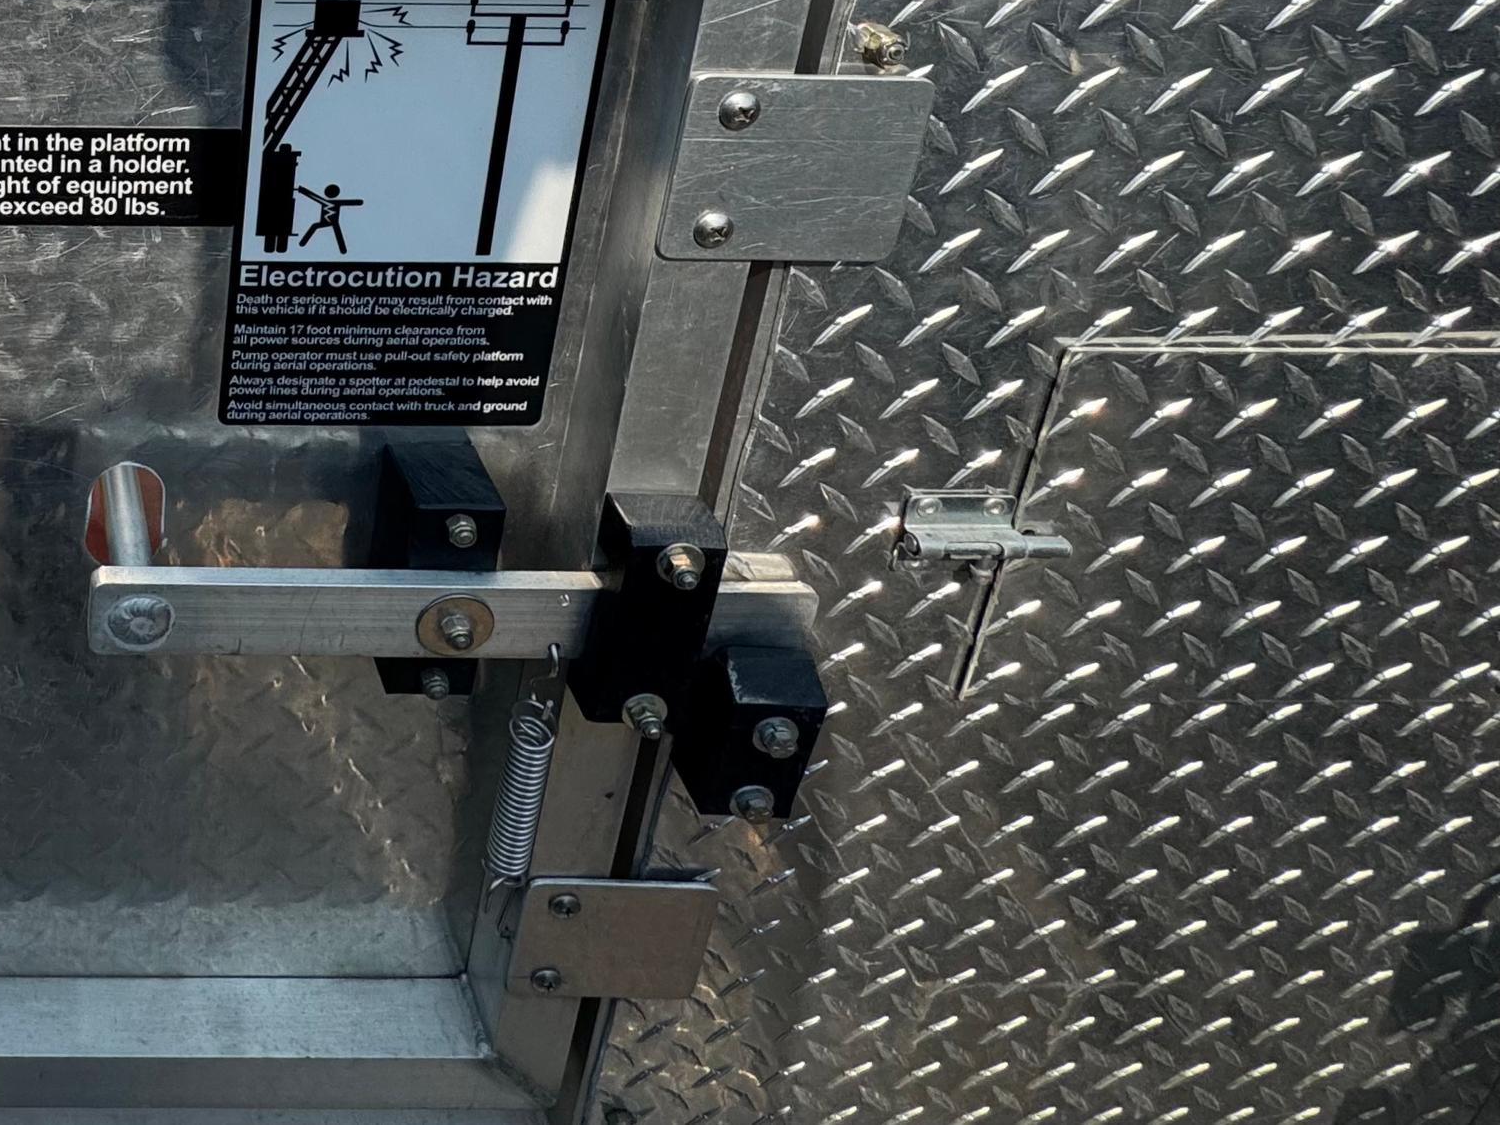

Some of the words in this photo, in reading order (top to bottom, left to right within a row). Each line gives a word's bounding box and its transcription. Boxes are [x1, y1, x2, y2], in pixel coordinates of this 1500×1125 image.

[18, 133, 39, 151] in
[46, 133, 83, 152] the
[91, 134, 190, 155] platform
[60, 155, 81, 172] in
[88, 160, 102, 173] a
[110, 155, 190, 173] holder.
[37, 177, 59, 194] of
[66, 177, 193, 199] equipment
[0, 198, 83, 215] exceed
[90, 199, 117, 215] 80
[125, 199, 166, 216] lbs.
[239, 265, 442, 288] Electrocution
[452, 266, 558, 288] Hazard
[237, 294, 273, 304] Death
[276, 296, 290, 304] or
[292, 295, 337, 304] serious
[341, 295, 375, 307] injury
[380, 297, 405, 307] may
[409, 296, 443, 305] result
[446, 295, 475, 305] from
[478, 296, 524, 306] contact
[527, 295, 552, 306] with
[236, 304, 258, 314] this
[262, 304, 305, 314] vehicle
[308, 305, 316, 314] if
[318, 305, 326, 314] it
[329, 305, 372, 315] should
[375, 305, 390, 315] be
[393, 306, 458, 317] electrically
[461, 306, 514, 317] charged.
[234, 324, 286, 334] Maintain
[290, 325, 305, 335] 17
[307, 325, 331, 335] foot
[333, 325, 391, 336] minimum
[395, 326, 453, 336] clearance
[457, 326, 485, 336] from
[233, 335, 247, 344] all
[250, 337, 289, 347] power
[291, 336, 340, 345] sources
[344, 336, 383, 347] during
[386, 336, 419, 346] aerial
[422, 336, 490, 347] operations.
[232, 350, 268, 361] Pump
[271, 352, 323, 361] operator
[326, 352, 357, 360] must
[385, 351, 431, 362] pull-out
[434, 352, 470, 363] safety
[473, 352, 524, 362] platform
[231, 361, 270, 372] during
[273, 361, 306, 370] aerial
[309, 361, 376, 372] operations.
[229, 375, 274, 386] Always
[277, 376, 335, 388] designate
[350, 376, 391, 388] spotter
[394, 377, 406, 386] at
[408, 376, 459, 388] pedestal
[462, 377, 474, 386] to
[477, 376, 503, 388] help
[505, 376, 539, 386] avoid
[229, 386, 266, 396] power
[269, 386, 298, 395] lines
[301, 386, 340, 397] during
[343, 386, 375, 396] aerial
[379, 385, 445, 398] operations.
[227, 400, 263, 410] Avoid
[265, 401, 346, 411] simultaneous
[349, 401, 396, 412] contact
[397, 401, 421, 411] with
[424, 401, 455, 411] truck
[458, 401, 481, 411] and
[483, 401, 527, 413] ground
[227, 410, 265, 422] during
[268, 411, 300, 420] aerial
[304, 411, 370, 422] operations.
